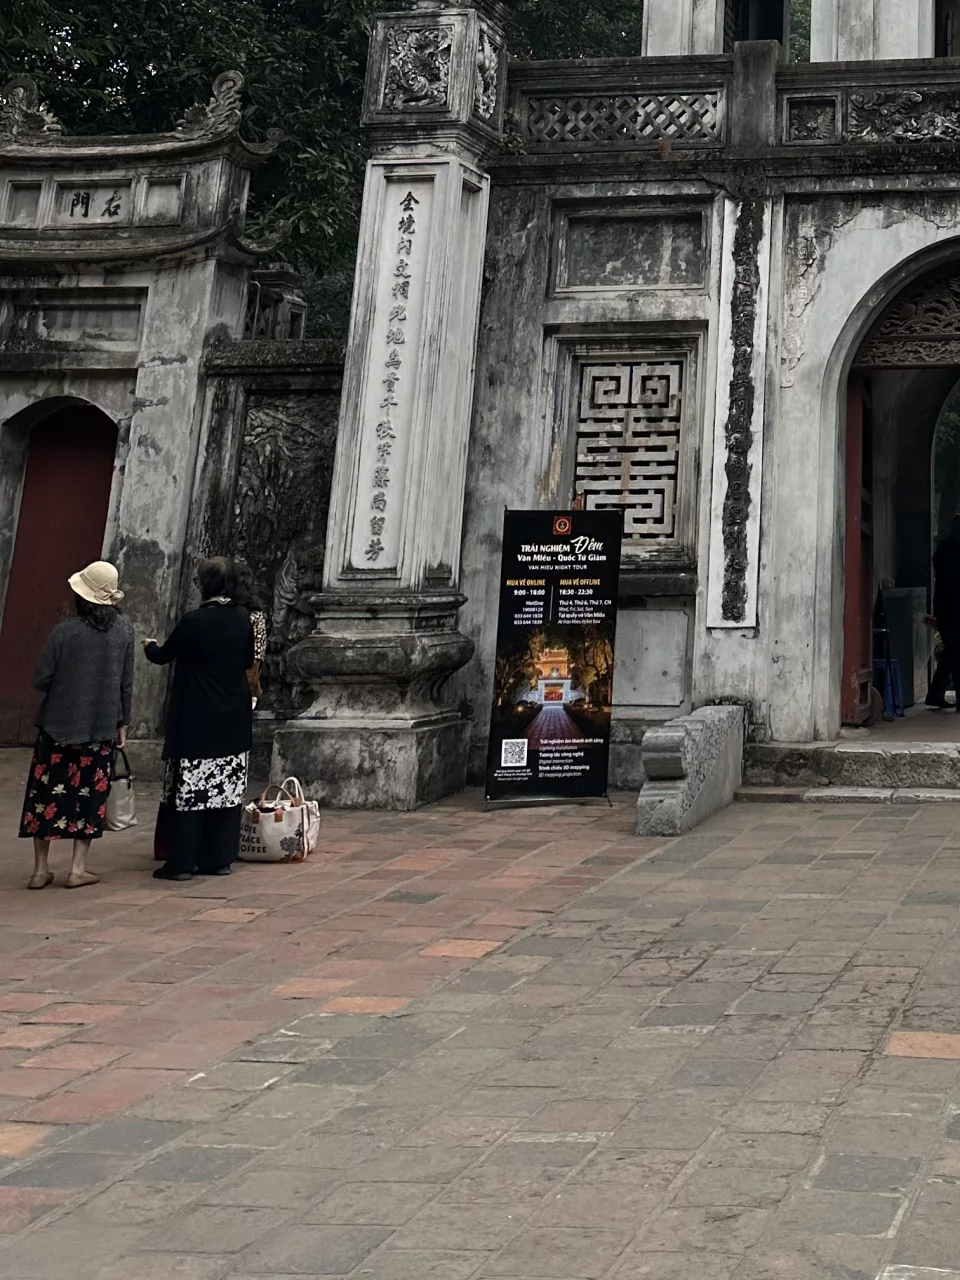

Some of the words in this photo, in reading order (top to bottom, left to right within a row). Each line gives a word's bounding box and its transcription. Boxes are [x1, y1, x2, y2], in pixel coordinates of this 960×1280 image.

[540, 543, 571, 553] NGHIỆM
[506, 579, 519, 587] MUA
[580, 578, 601, 586] OFFLINE
[240, 844, 267, 852] OFFEE
